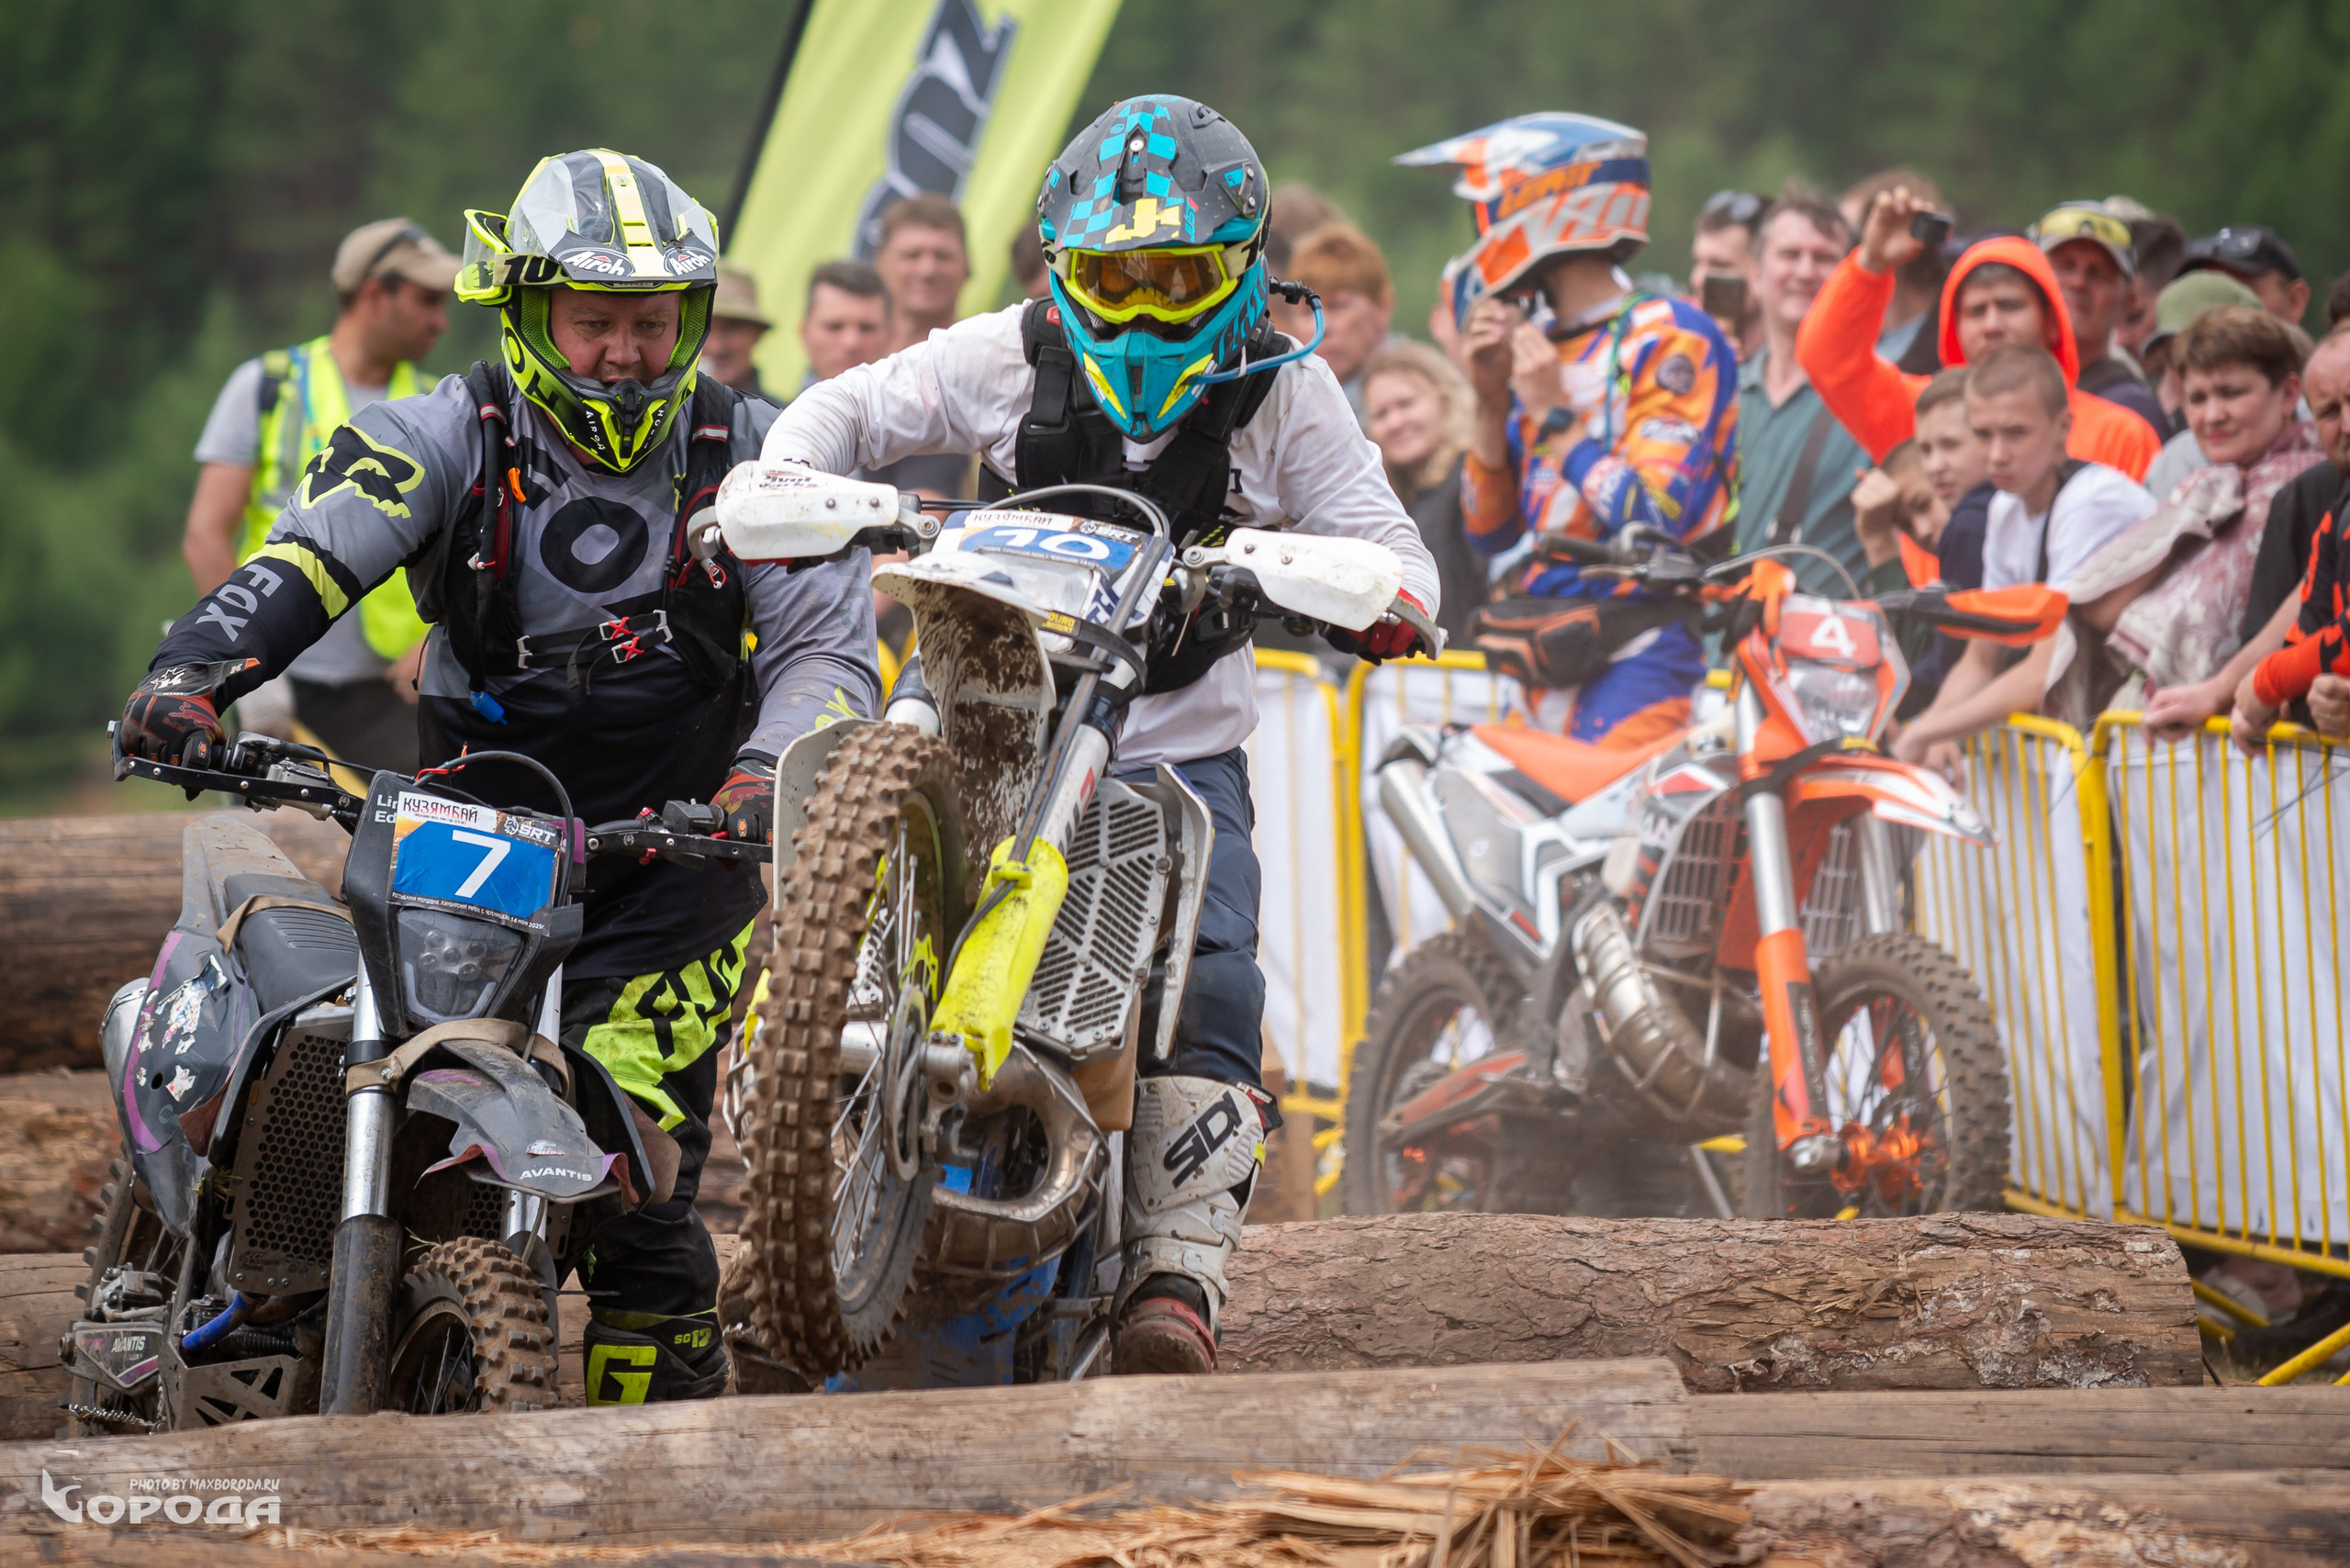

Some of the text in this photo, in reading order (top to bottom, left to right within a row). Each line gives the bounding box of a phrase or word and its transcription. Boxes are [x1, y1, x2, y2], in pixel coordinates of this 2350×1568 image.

[563, 251, 625, 275] Airoh
[671, 251, 711, 275] Airoh
[195, 564, 284, 642] FOX
[1810, 616, 1857, 657] 4
[403, 797, 478, 823] КУЗЯМБАЙ
[518, 823, 556, 842] SRT
[452, 830, 511, 899] 7
[520, 1167, 593, 1182] AVANTIS
[111, 1335, 147, 1353] AVANTIS
